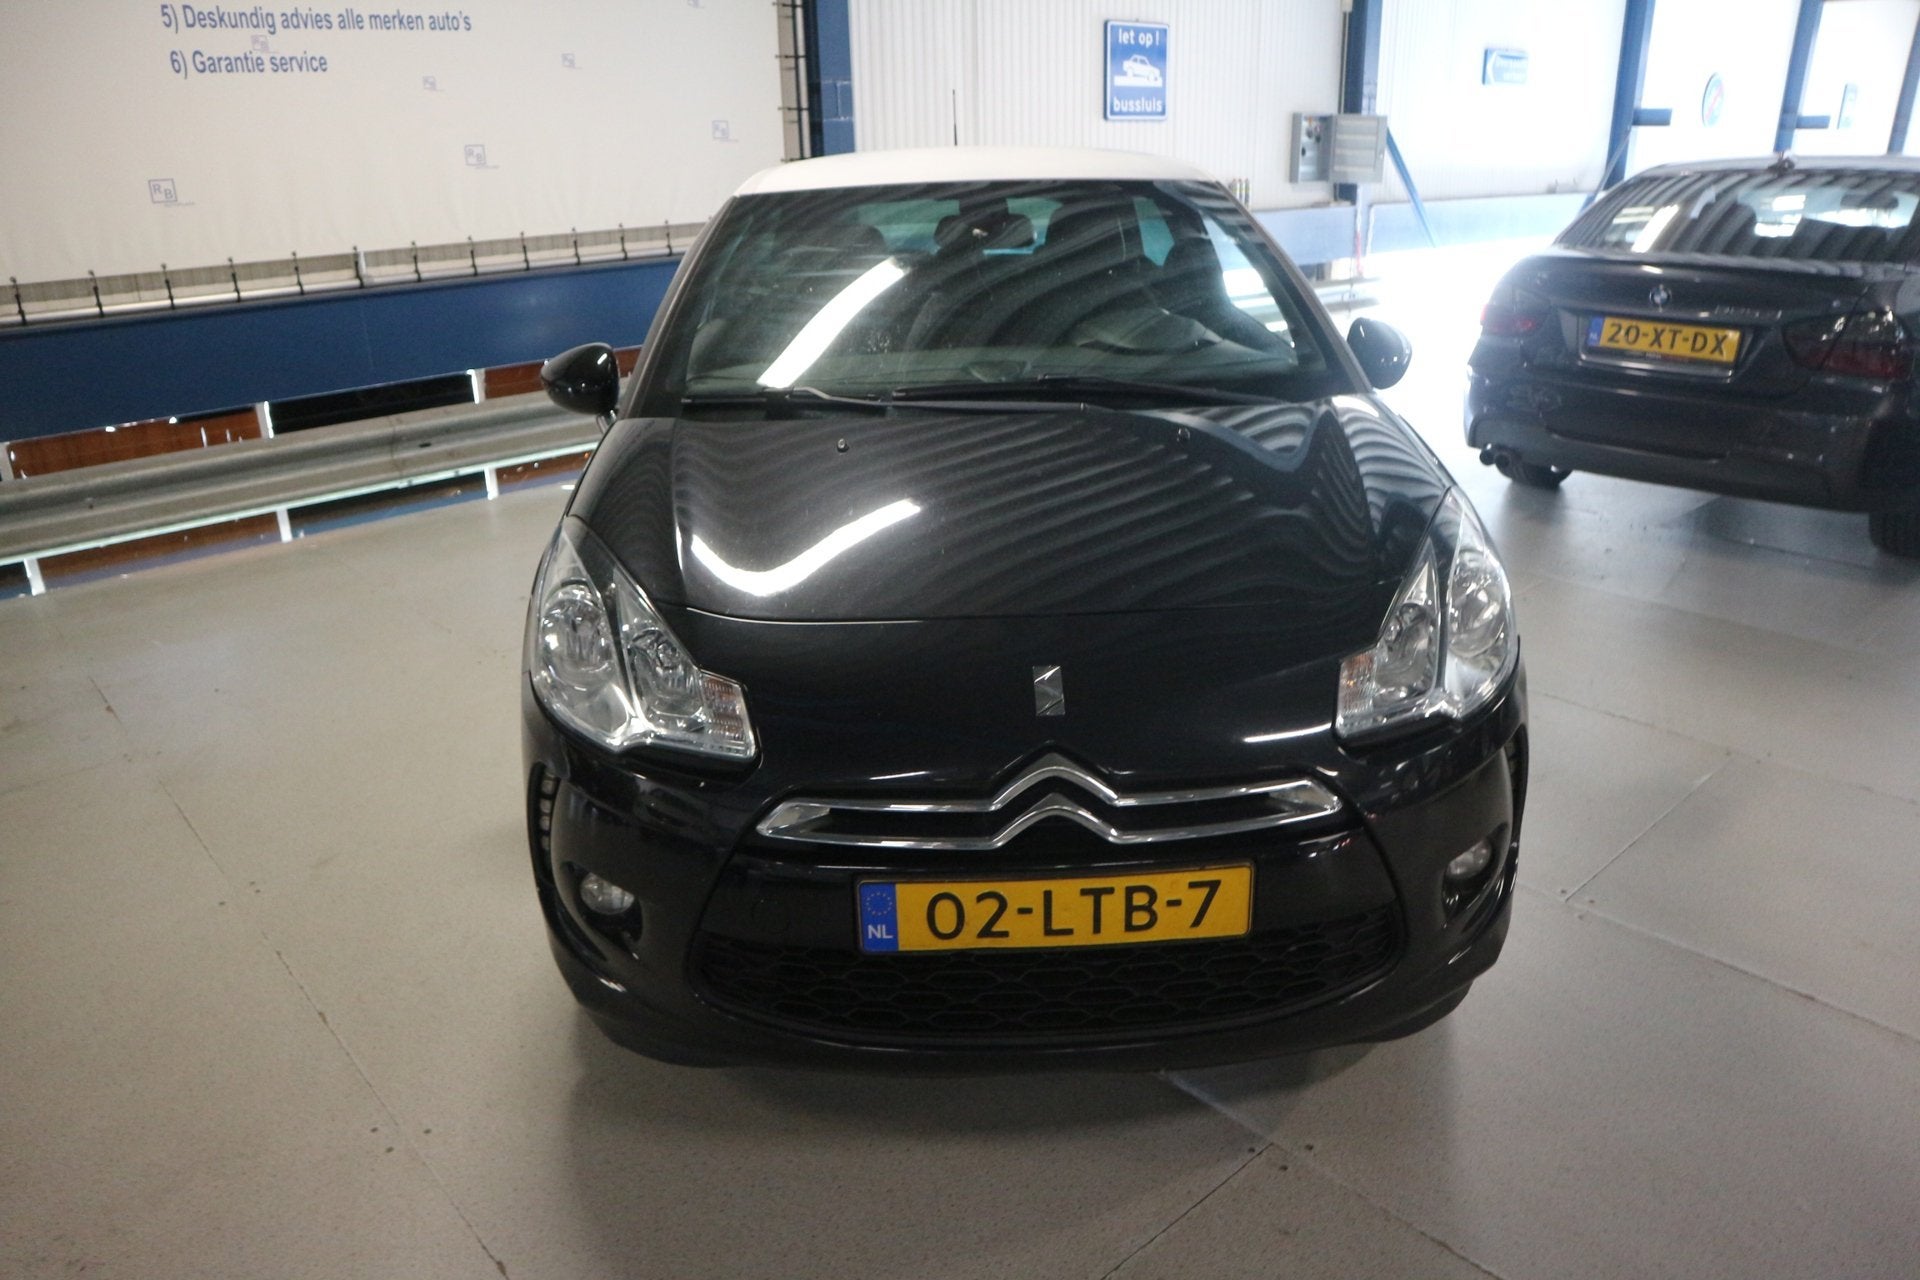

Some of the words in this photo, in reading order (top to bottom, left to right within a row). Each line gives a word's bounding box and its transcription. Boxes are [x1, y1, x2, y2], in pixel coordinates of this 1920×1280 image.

[160, 4, 179, 34] 5)
[182, 5, 277, 35] Deskundig
[280, 7, 333, 30] advies
[337, 8, 364, 30] alle
[368, 9, 424, 31] merken
[428, 10, 472, 31] auto's
[1118, 28, 1135, 45] let
[1138, 32, 1153, 48] op
[170, 50, 188, 79] 6)
[192, 50, 265, 74] Garantie
[269, 51, 328, 73] service
[1113, 97, 1163, 113] bussluis
[1607, 322, 1728, 357] 20-XT-DX
[867, 924, 893, 939] NL
[926, 879, 1222, 941] 02-LTB-7
